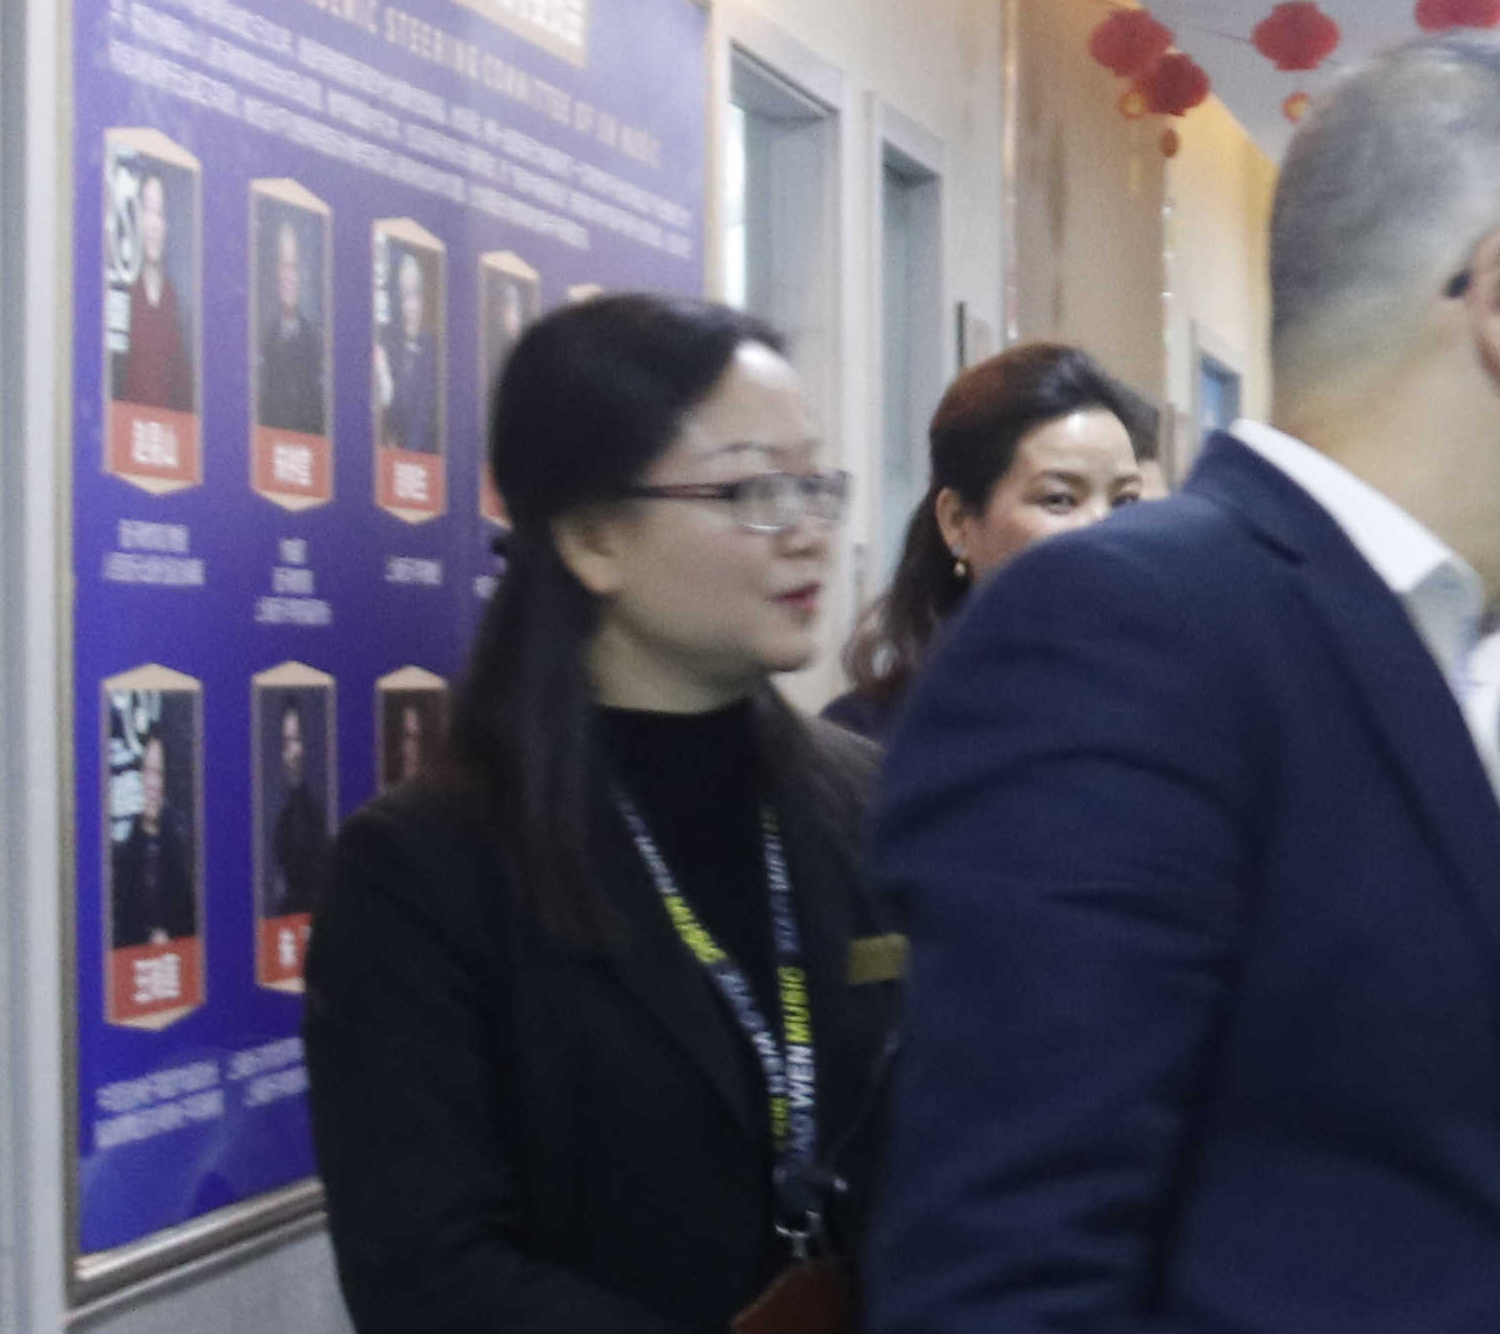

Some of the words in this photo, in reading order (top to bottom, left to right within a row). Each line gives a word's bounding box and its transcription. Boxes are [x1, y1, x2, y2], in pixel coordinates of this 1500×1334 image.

[384, 5, 479, 80] STEERING
[777, 966, 814, 1043] MUSIC
[785, 1042, 815, 1109] WEN
